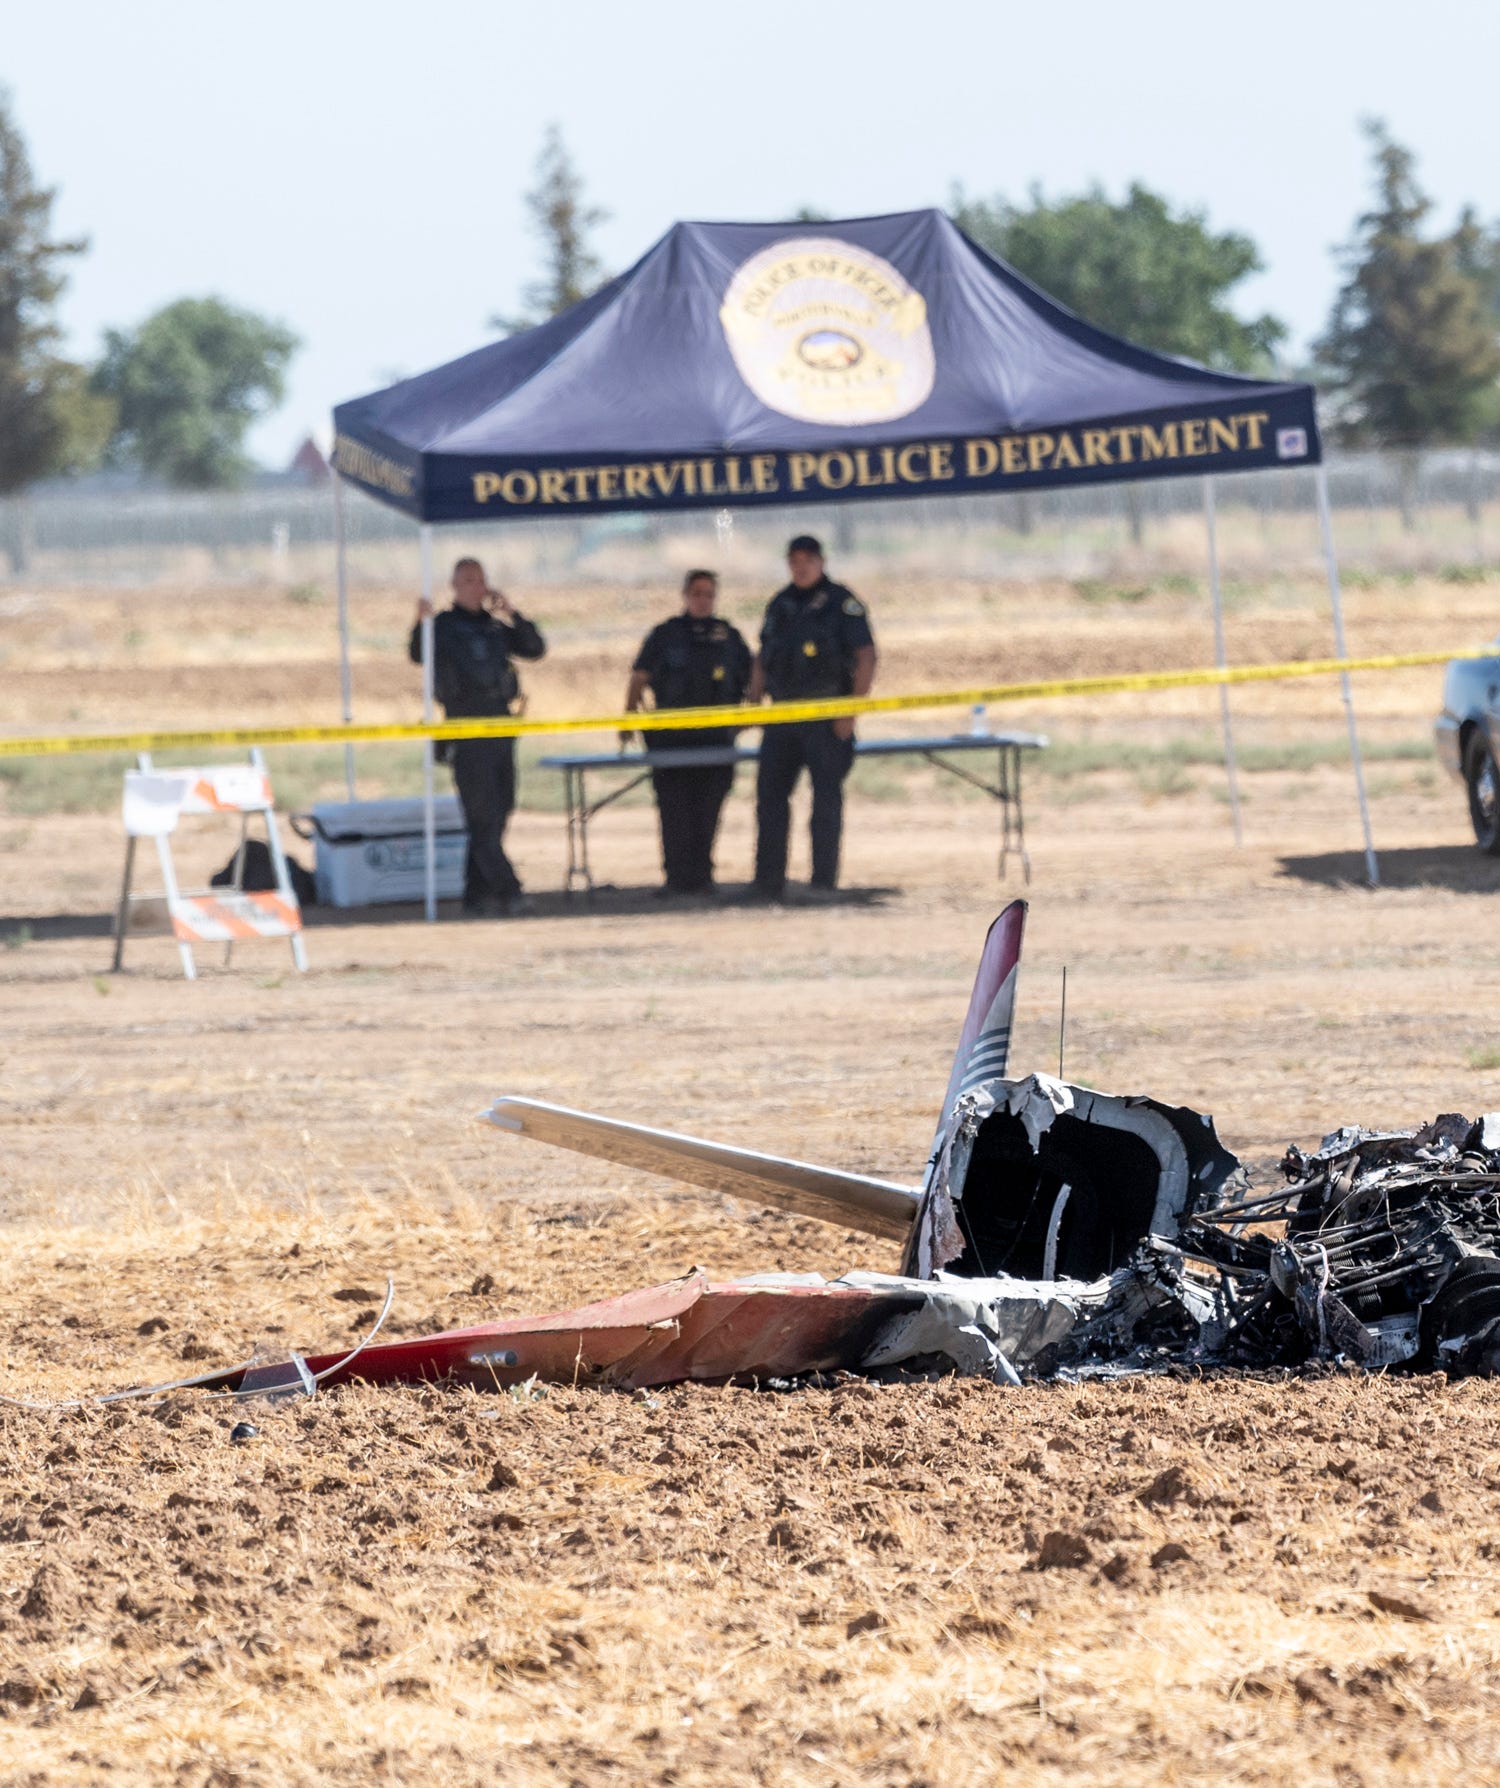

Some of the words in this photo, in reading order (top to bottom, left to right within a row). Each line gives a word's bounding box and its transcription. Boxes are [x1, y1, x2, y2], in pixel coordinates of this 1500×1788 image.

[743, 262, 800, 317] POLICE
[472, 453, 779, 504] PORTERVILLE
[788, 442, 954, 492] POLICE
[965, 411, 1270, 478] DEPARTMENT
